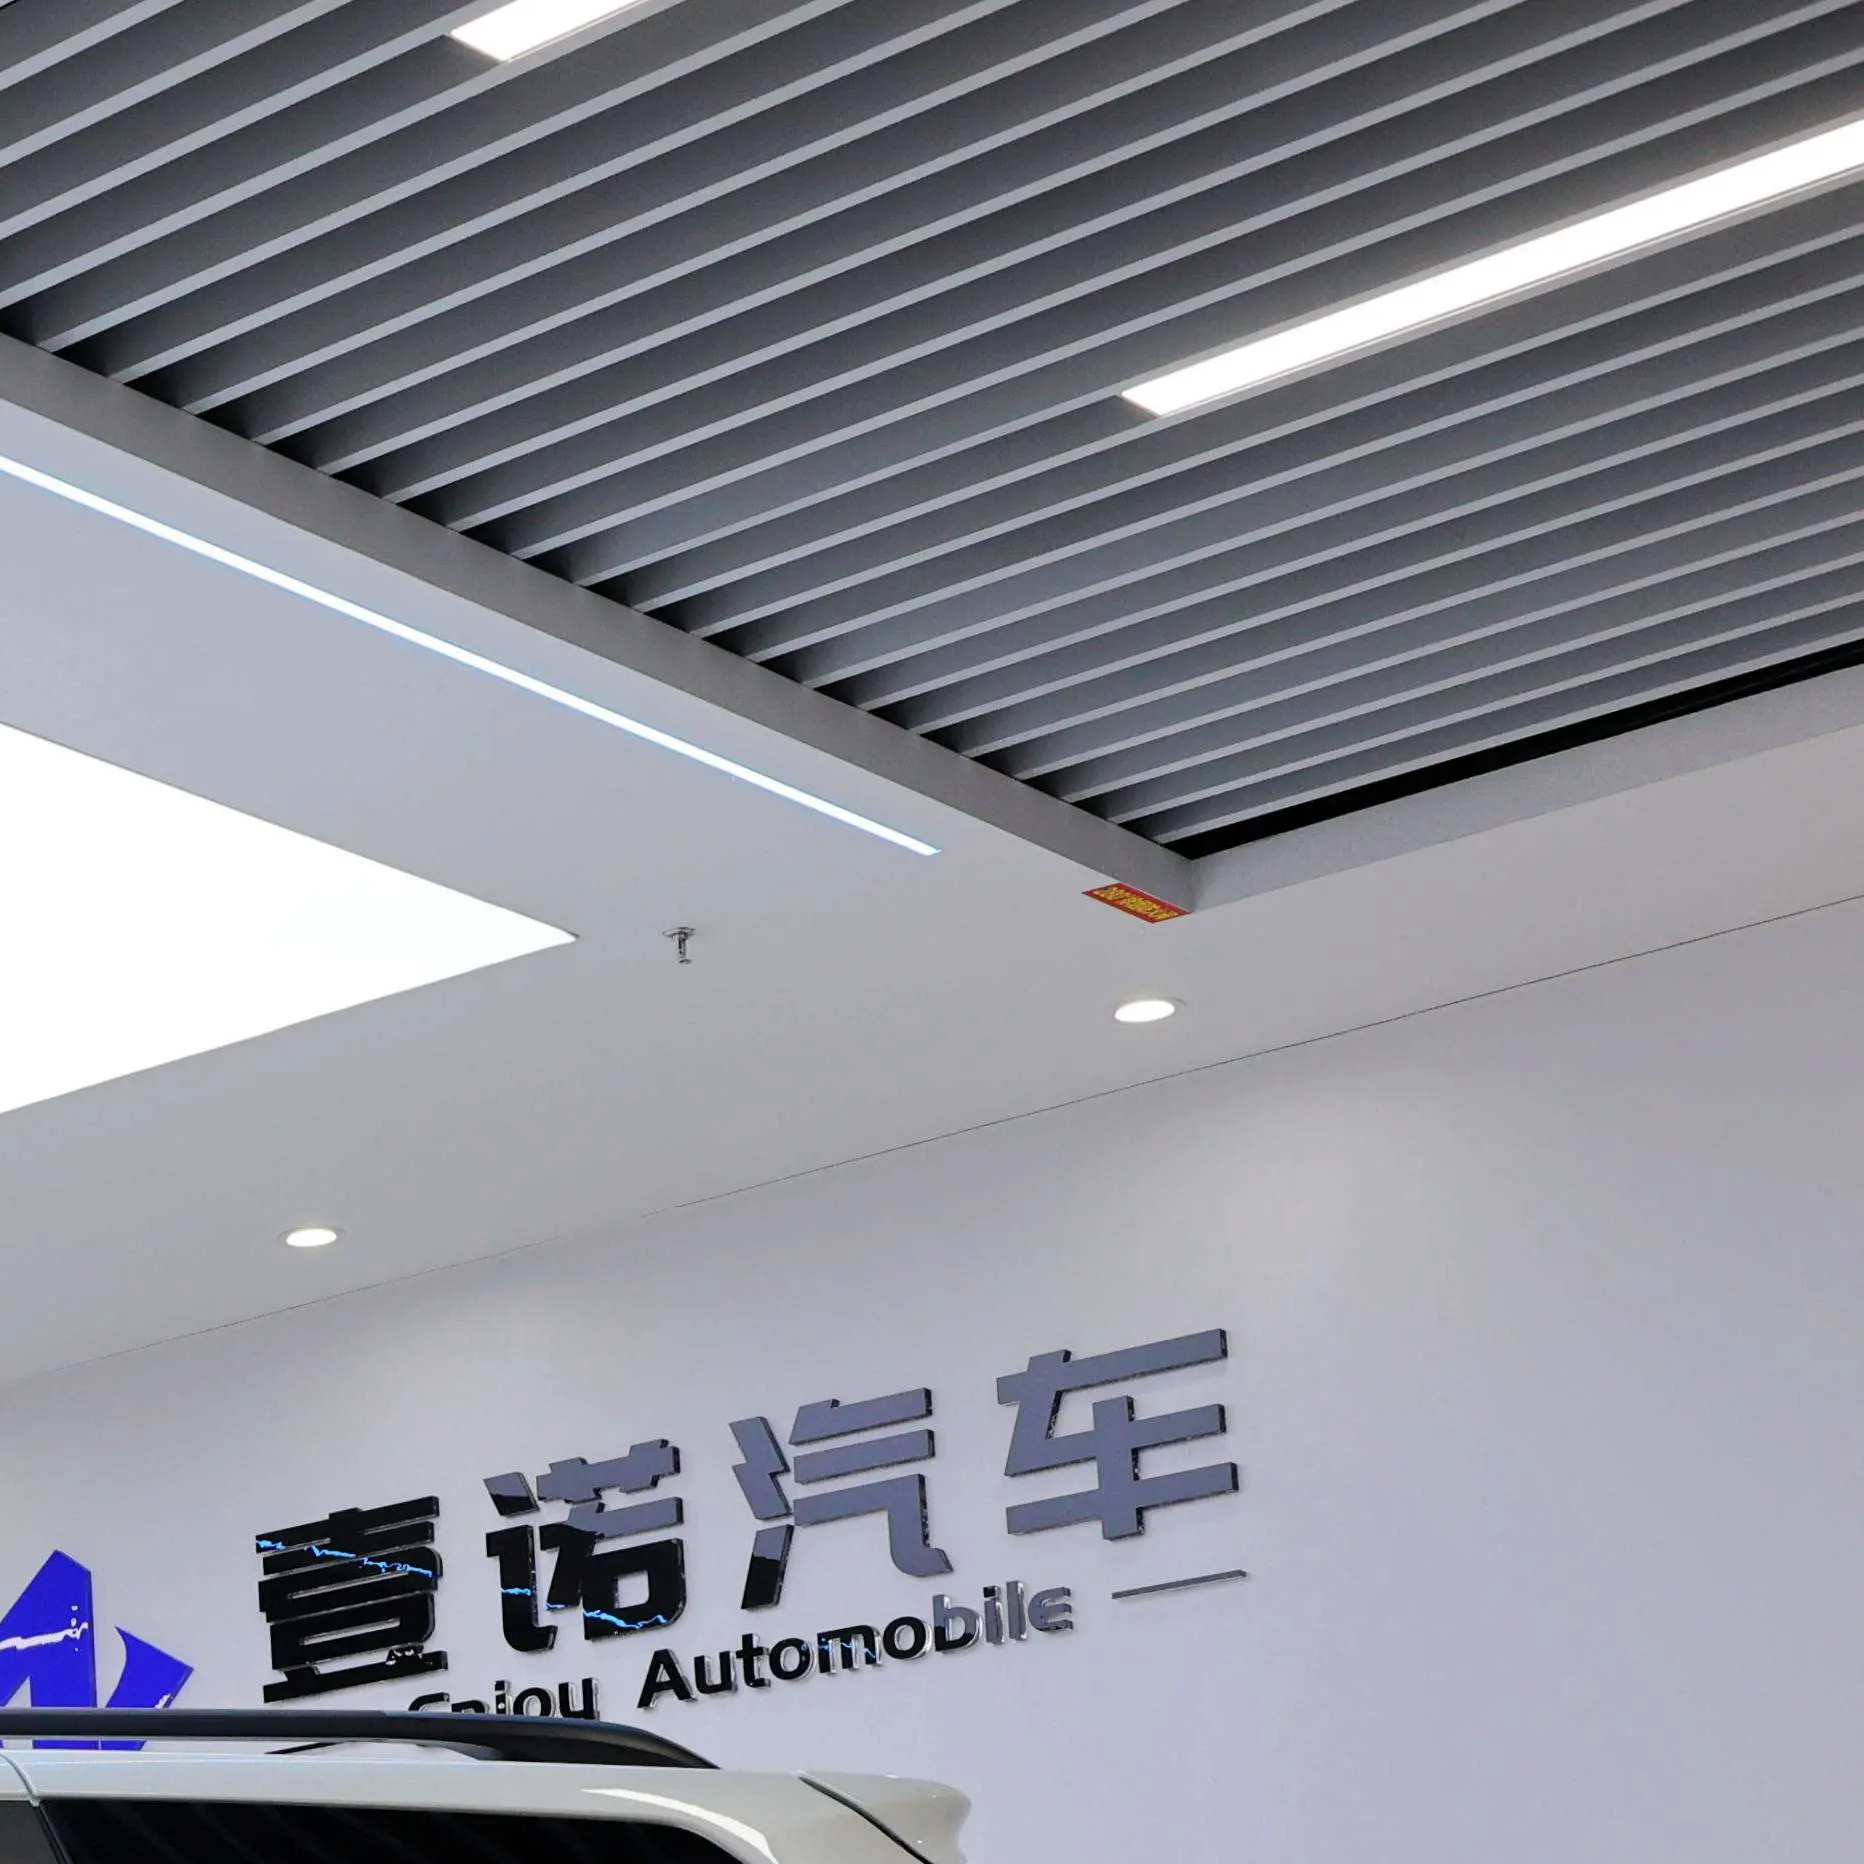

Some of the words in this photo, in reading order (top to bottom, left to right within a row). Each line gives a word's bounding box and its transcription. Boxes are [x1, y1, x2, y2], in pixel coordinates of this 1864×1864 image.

[255, 1328, 1240, 1703] 壹诺汽车
[637, 1580, 1072, 1709] Automobile
